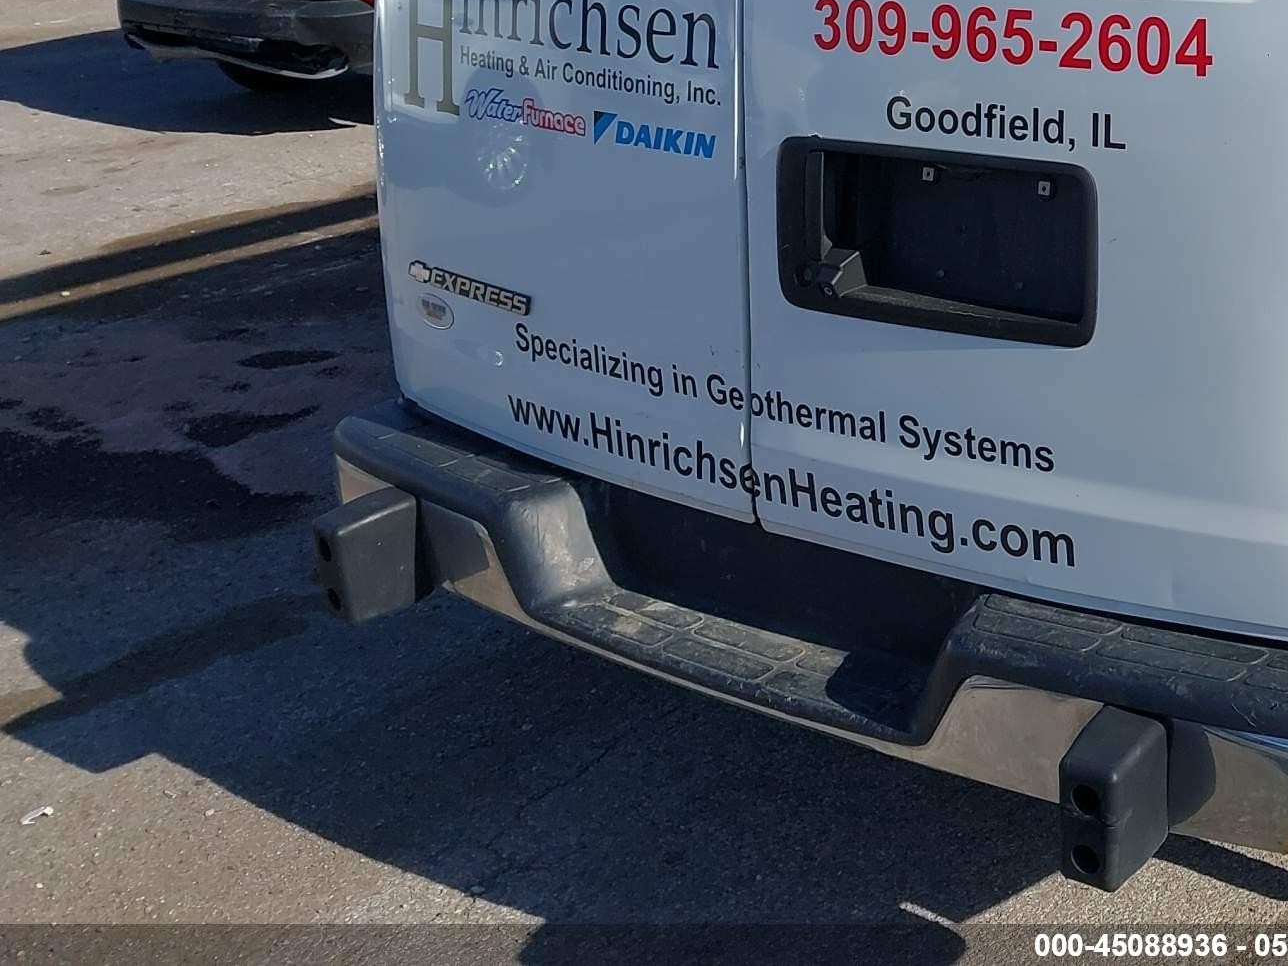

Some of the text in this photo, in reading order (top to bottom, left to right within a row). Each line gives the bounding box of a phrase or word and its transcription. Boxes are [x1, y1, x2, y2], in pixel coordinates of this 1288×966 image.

[460, 45, 722, 106] Heating & Air Conditioning, Inc.
[615, 121, 716, 159] DAIKIN
[886, 95, 1128, 152] Goodfield, IL
[430, 268, 527, 315] EXPRESS
[515, 322, 1055, 473] Specializing in Geothermal Systems
[508, 394, 1076, 567] www.HinrichsenHeating.com
